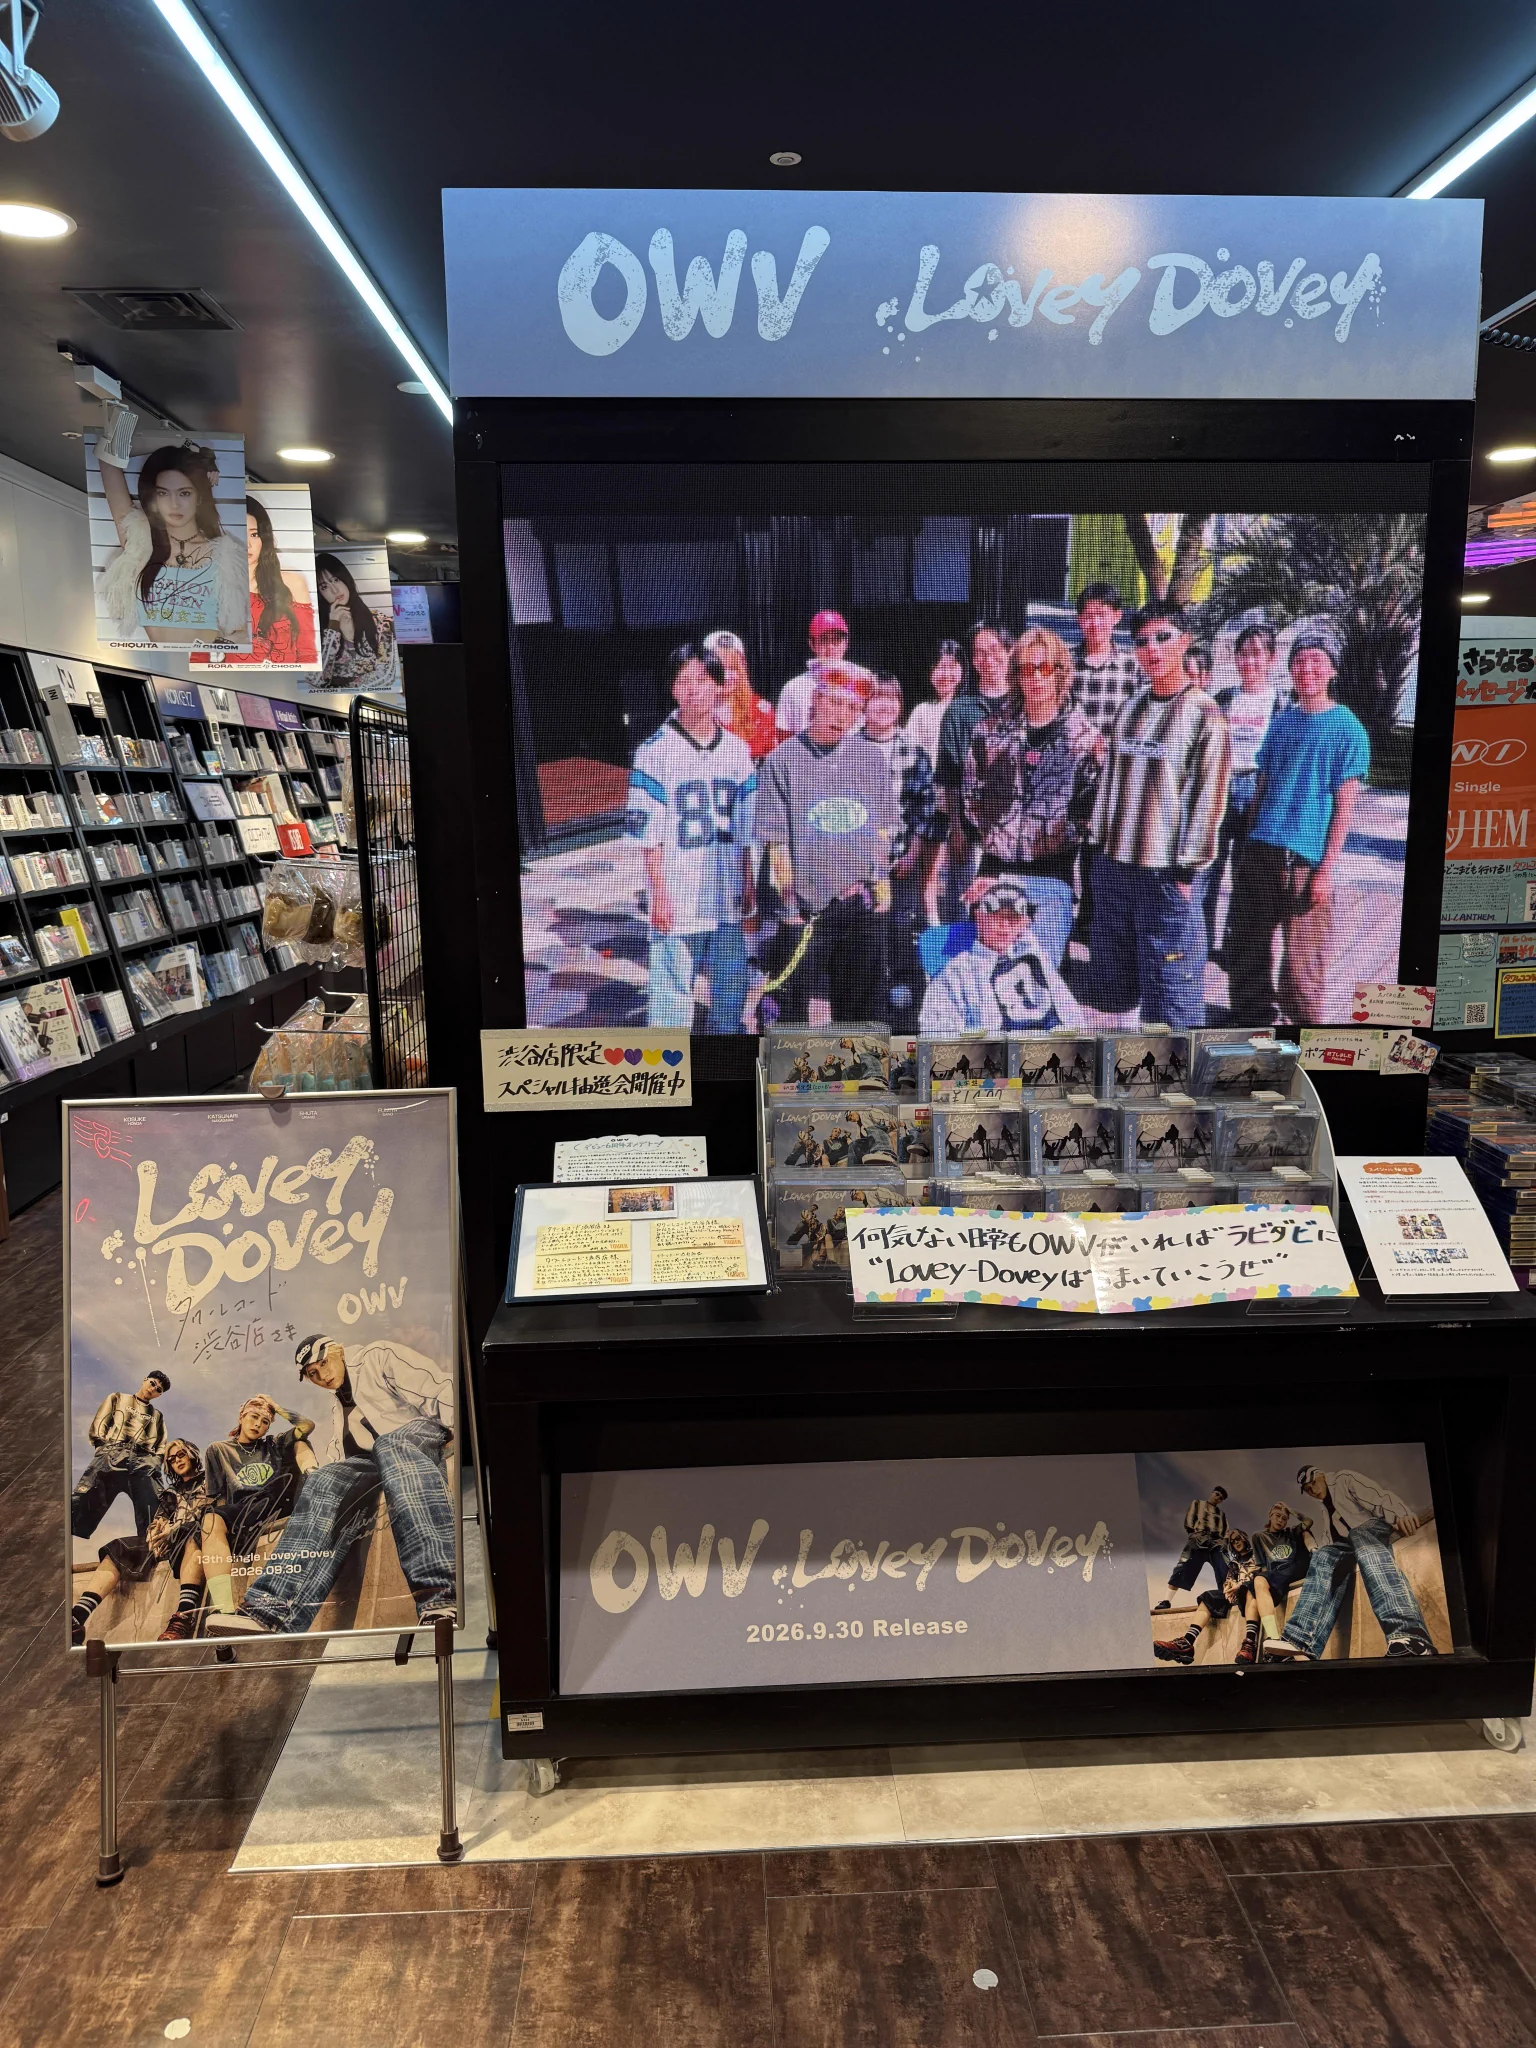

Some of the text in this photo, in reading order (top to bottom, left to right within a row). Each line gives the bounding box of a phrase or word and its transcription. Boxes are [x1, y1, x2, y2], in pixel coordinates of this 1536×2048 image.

[557, 225, 831, 357] OWV
[1454, 782, 1501, 794] Single
[498, 1041, 606, 1067] 渋谷店限定
[1305, 1047, 1370, 1060] ポスド
[498, 1071, 686, 1099] スペシャル抽選会開催中
[337, 1276, 408, 1325] OWV
[197, 1549, 337, 1565] 13th single Lovey-Dovey
[230, 1564, 302, 1577] 2026.09.30
[590, 1518, 770, 1613] OWV
[745, 1616, 969, 1644] 2026.9.30 Release
